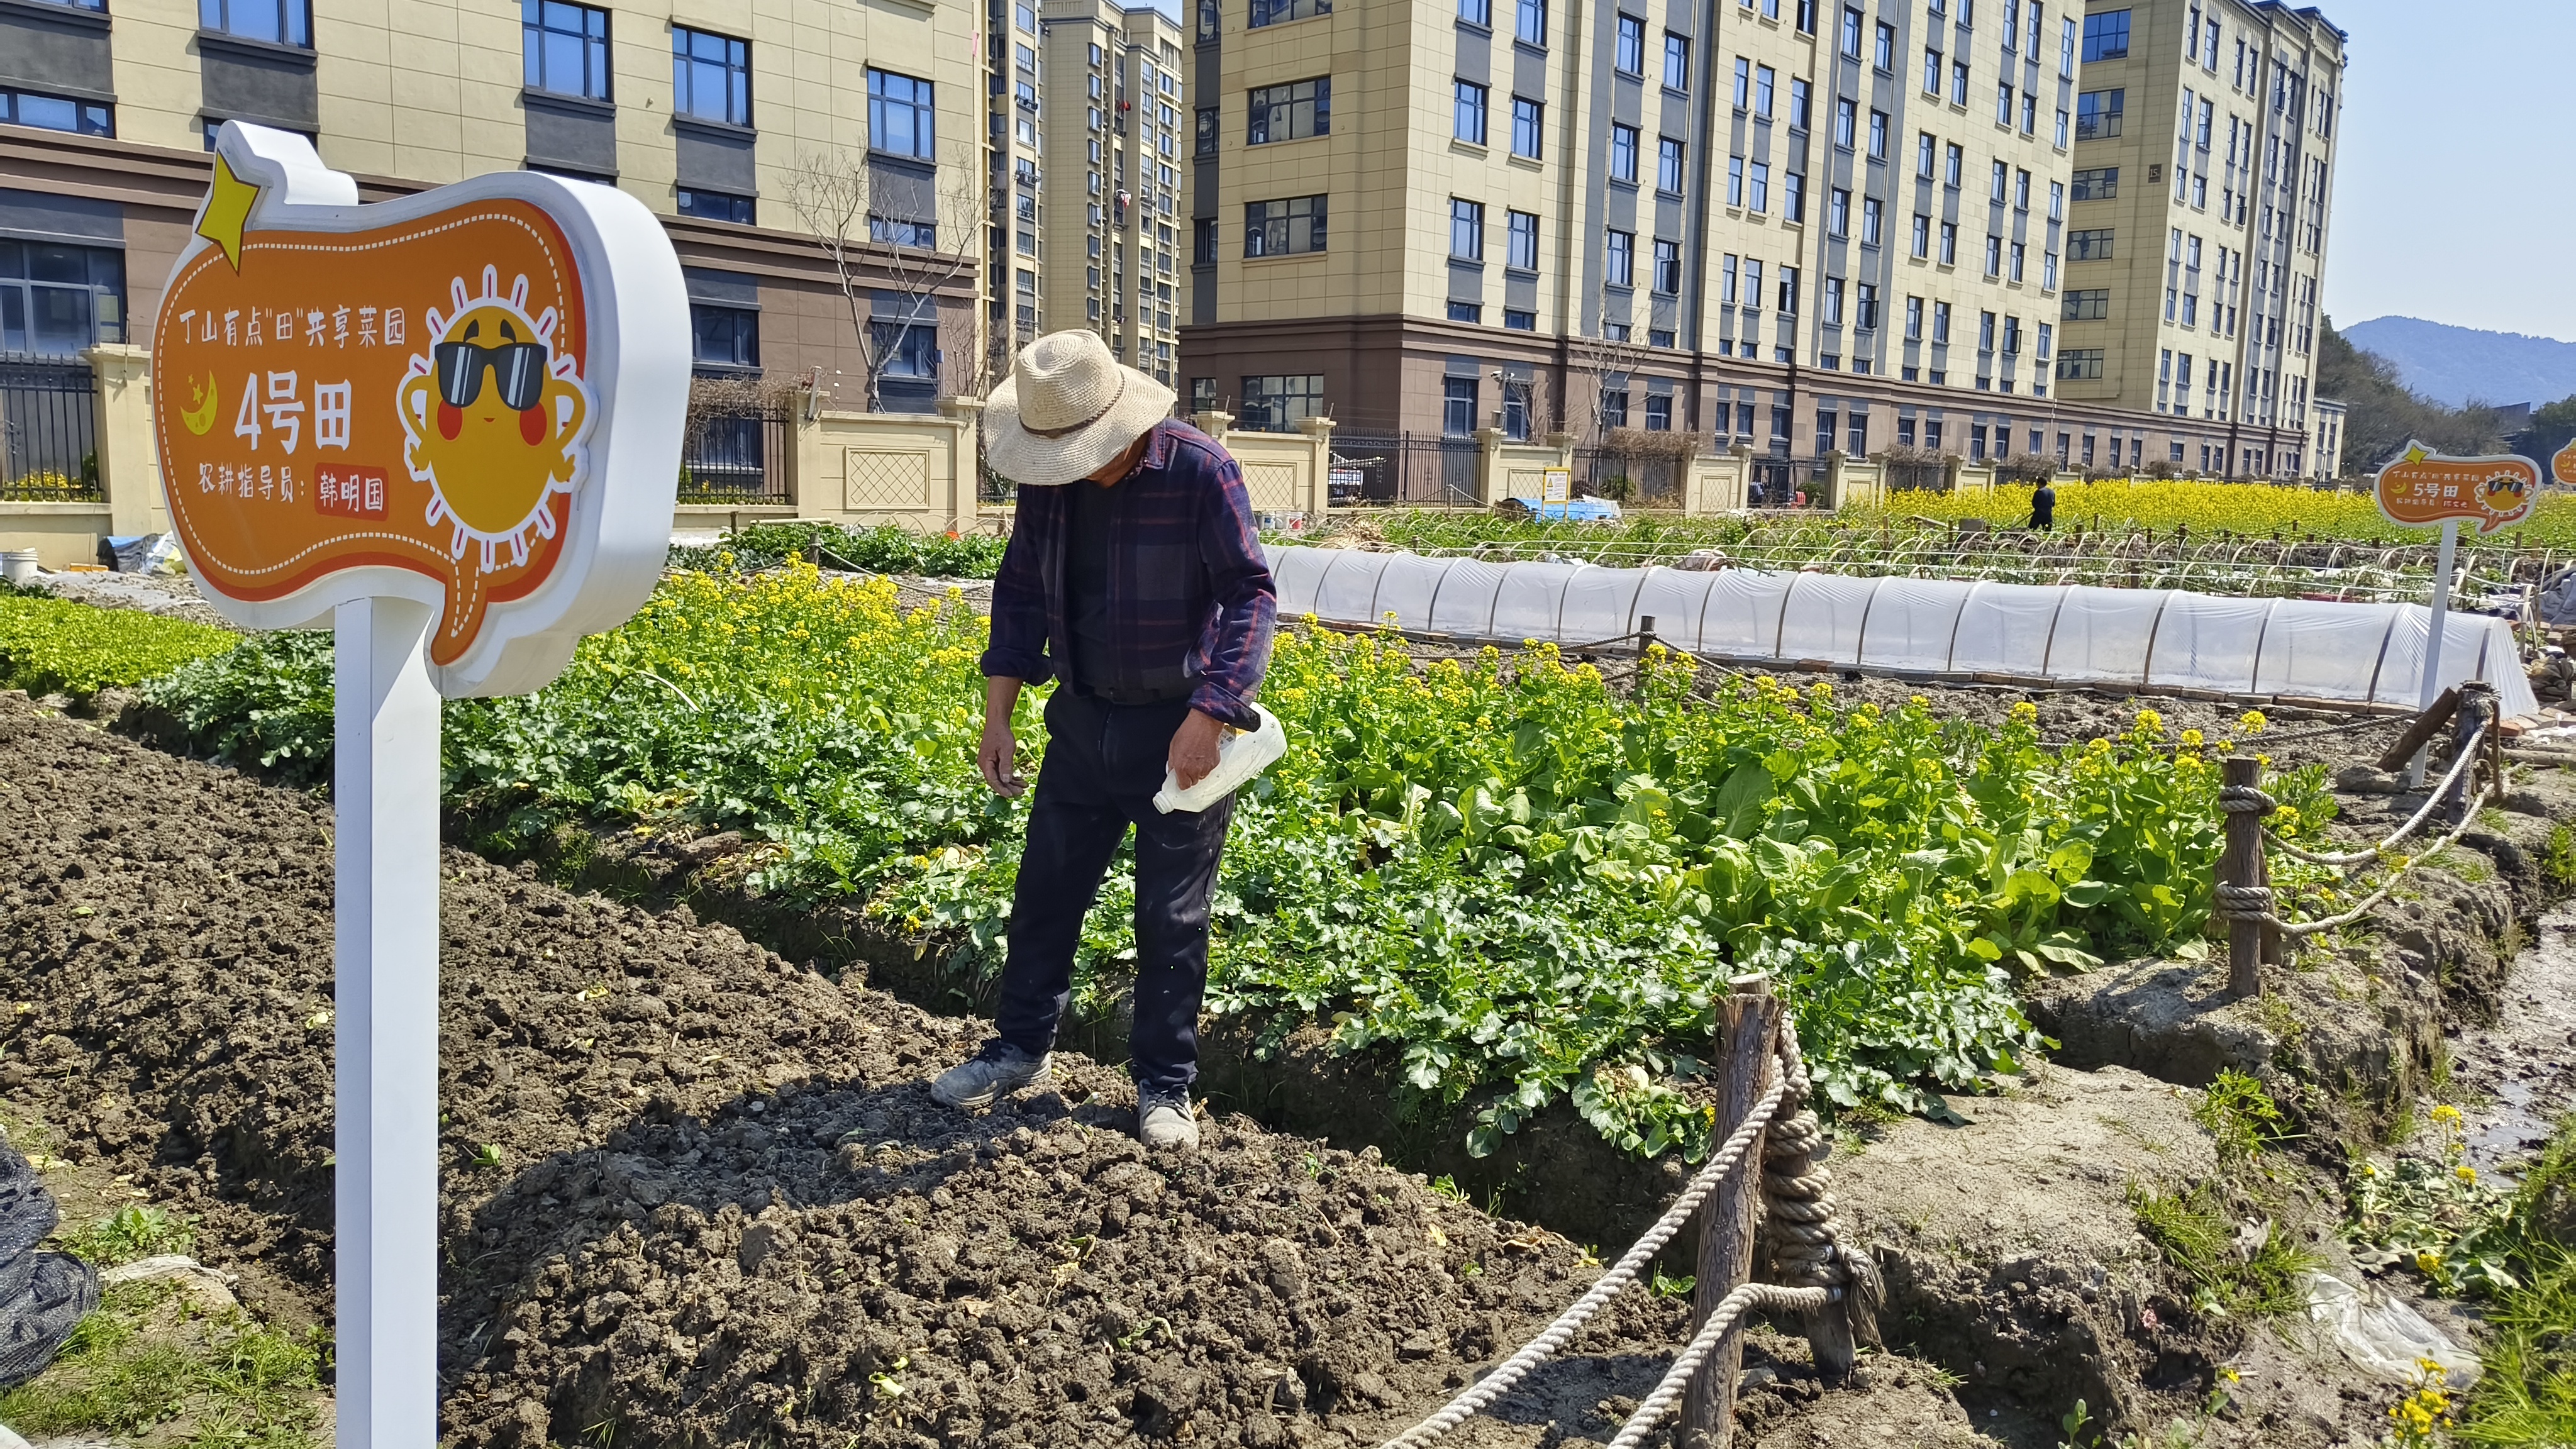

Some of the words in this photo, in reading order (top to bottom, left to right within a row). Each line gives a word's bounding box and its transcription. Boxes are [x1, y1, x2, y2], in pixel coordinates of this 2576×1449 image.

[234, 369, 352, 455] 4号田
[319, 471, 384, 513] 韩明国
[2412, 482, 2458, 498] 5号田
